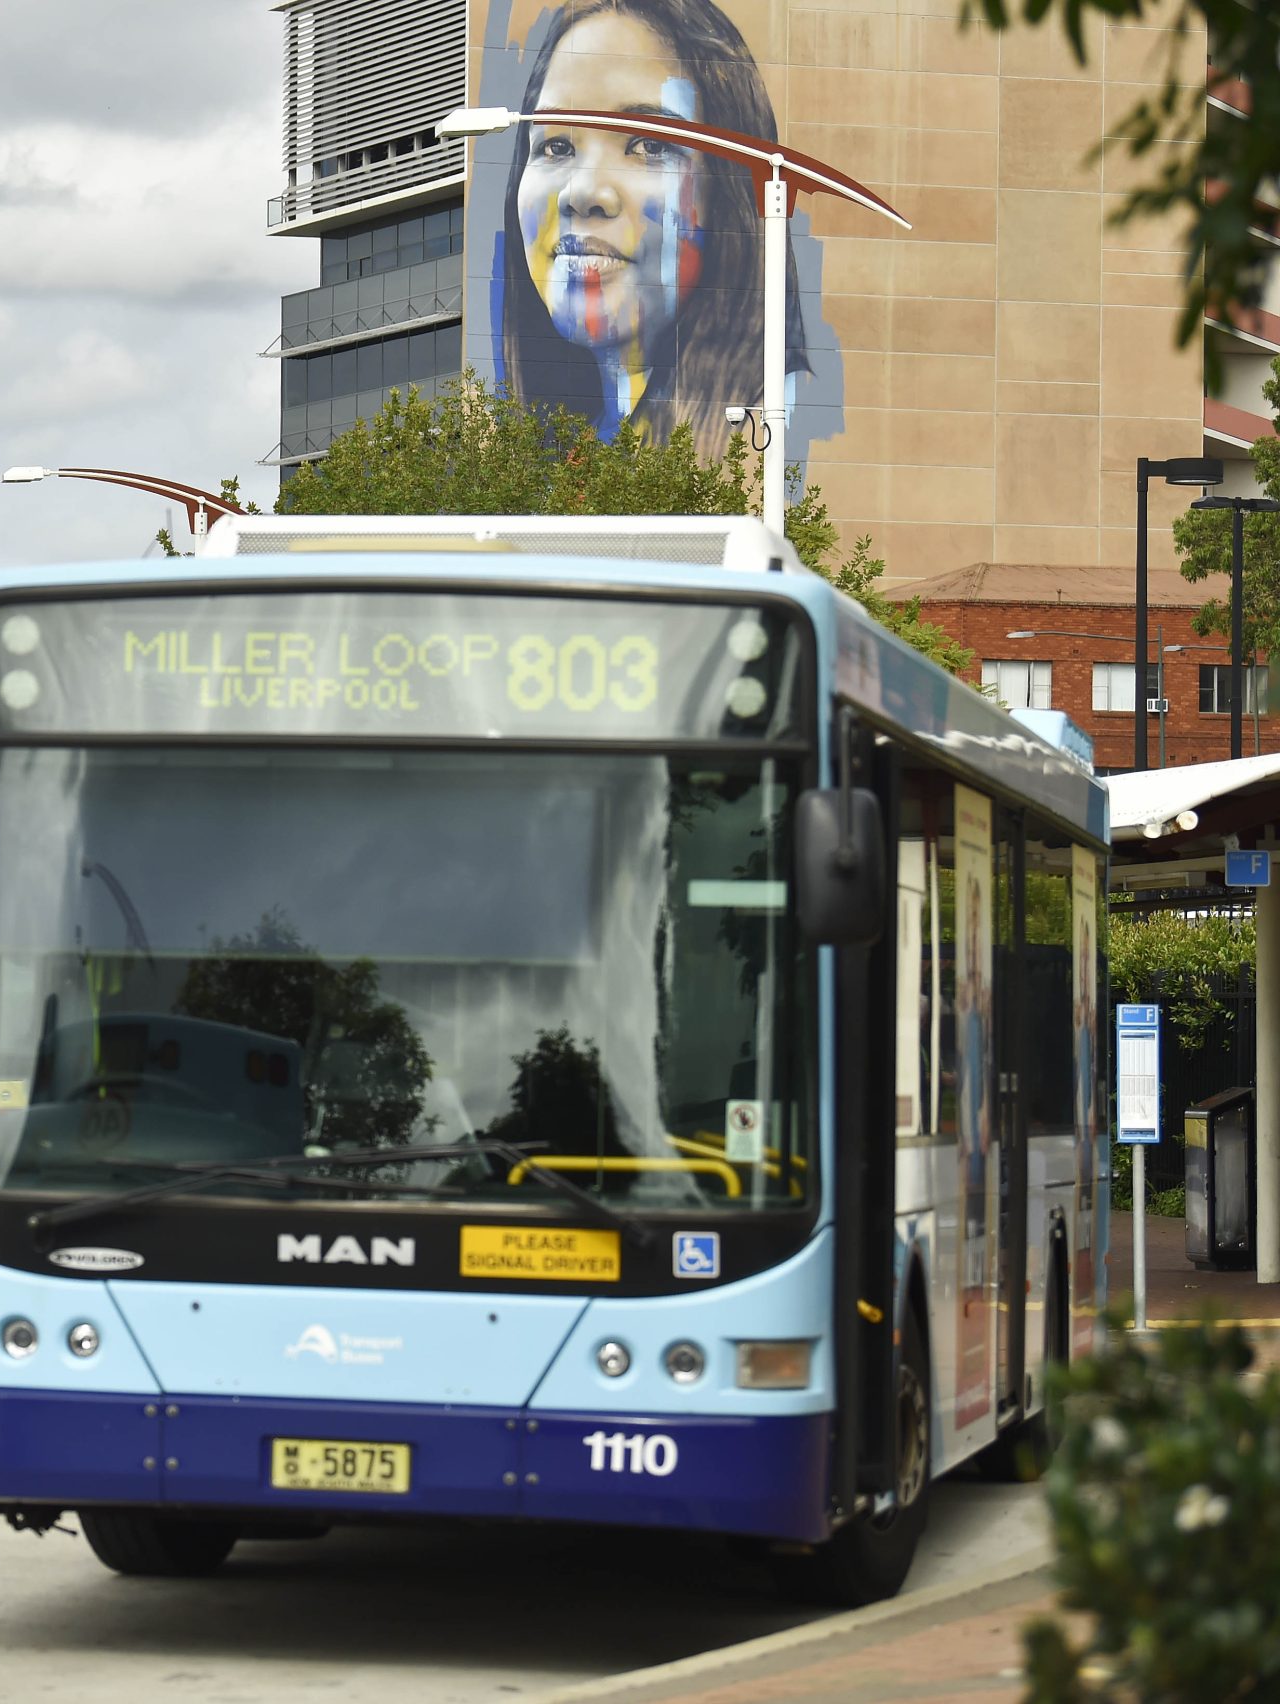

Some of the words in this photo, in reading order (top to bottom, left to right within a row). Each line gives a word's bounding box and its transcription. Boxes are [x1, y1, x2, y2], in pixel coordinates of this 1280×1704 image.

[123, 631, 316, 675] MILLER
[339, 633, 500, 677] LOOP
[506, 634, 659, 712] 803
[199, 676, 420, 711] LIVERPOOL
[1251, 854, 1263, 874] F
[1145, 1008, 1155, 1021] F
[277, 1233, 415, 1266] MAN
[502, 1233, 577, 1252] PLEASE
[465, 1253, 536, 1272] SIGNAL
[544, 1254, 615, 1273] DRIVER
[582, 1431, 678, 1476] 1110
